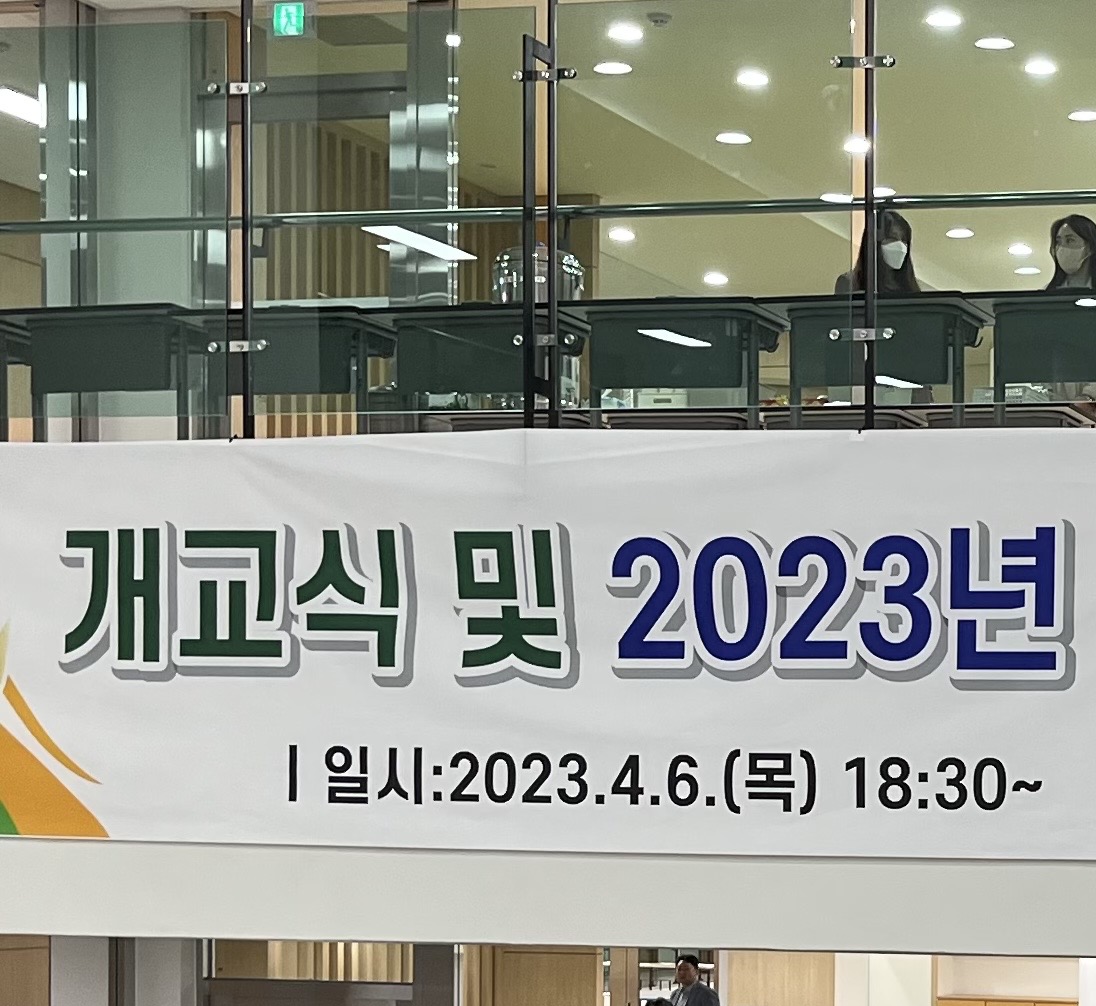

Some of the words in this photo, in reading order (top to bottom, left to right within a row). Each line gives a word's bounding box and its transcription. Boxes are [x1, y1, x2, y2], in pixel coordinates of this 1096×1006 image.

[63, 528, 400, 669] 개교식
[453, 528, 563, 670] 및
[611, 525, 1058, 672] 2023년
[324, 744, 818, 816] 일시:2023.4.6.(목)
[844, 755, 1045, 812] 18:30~
